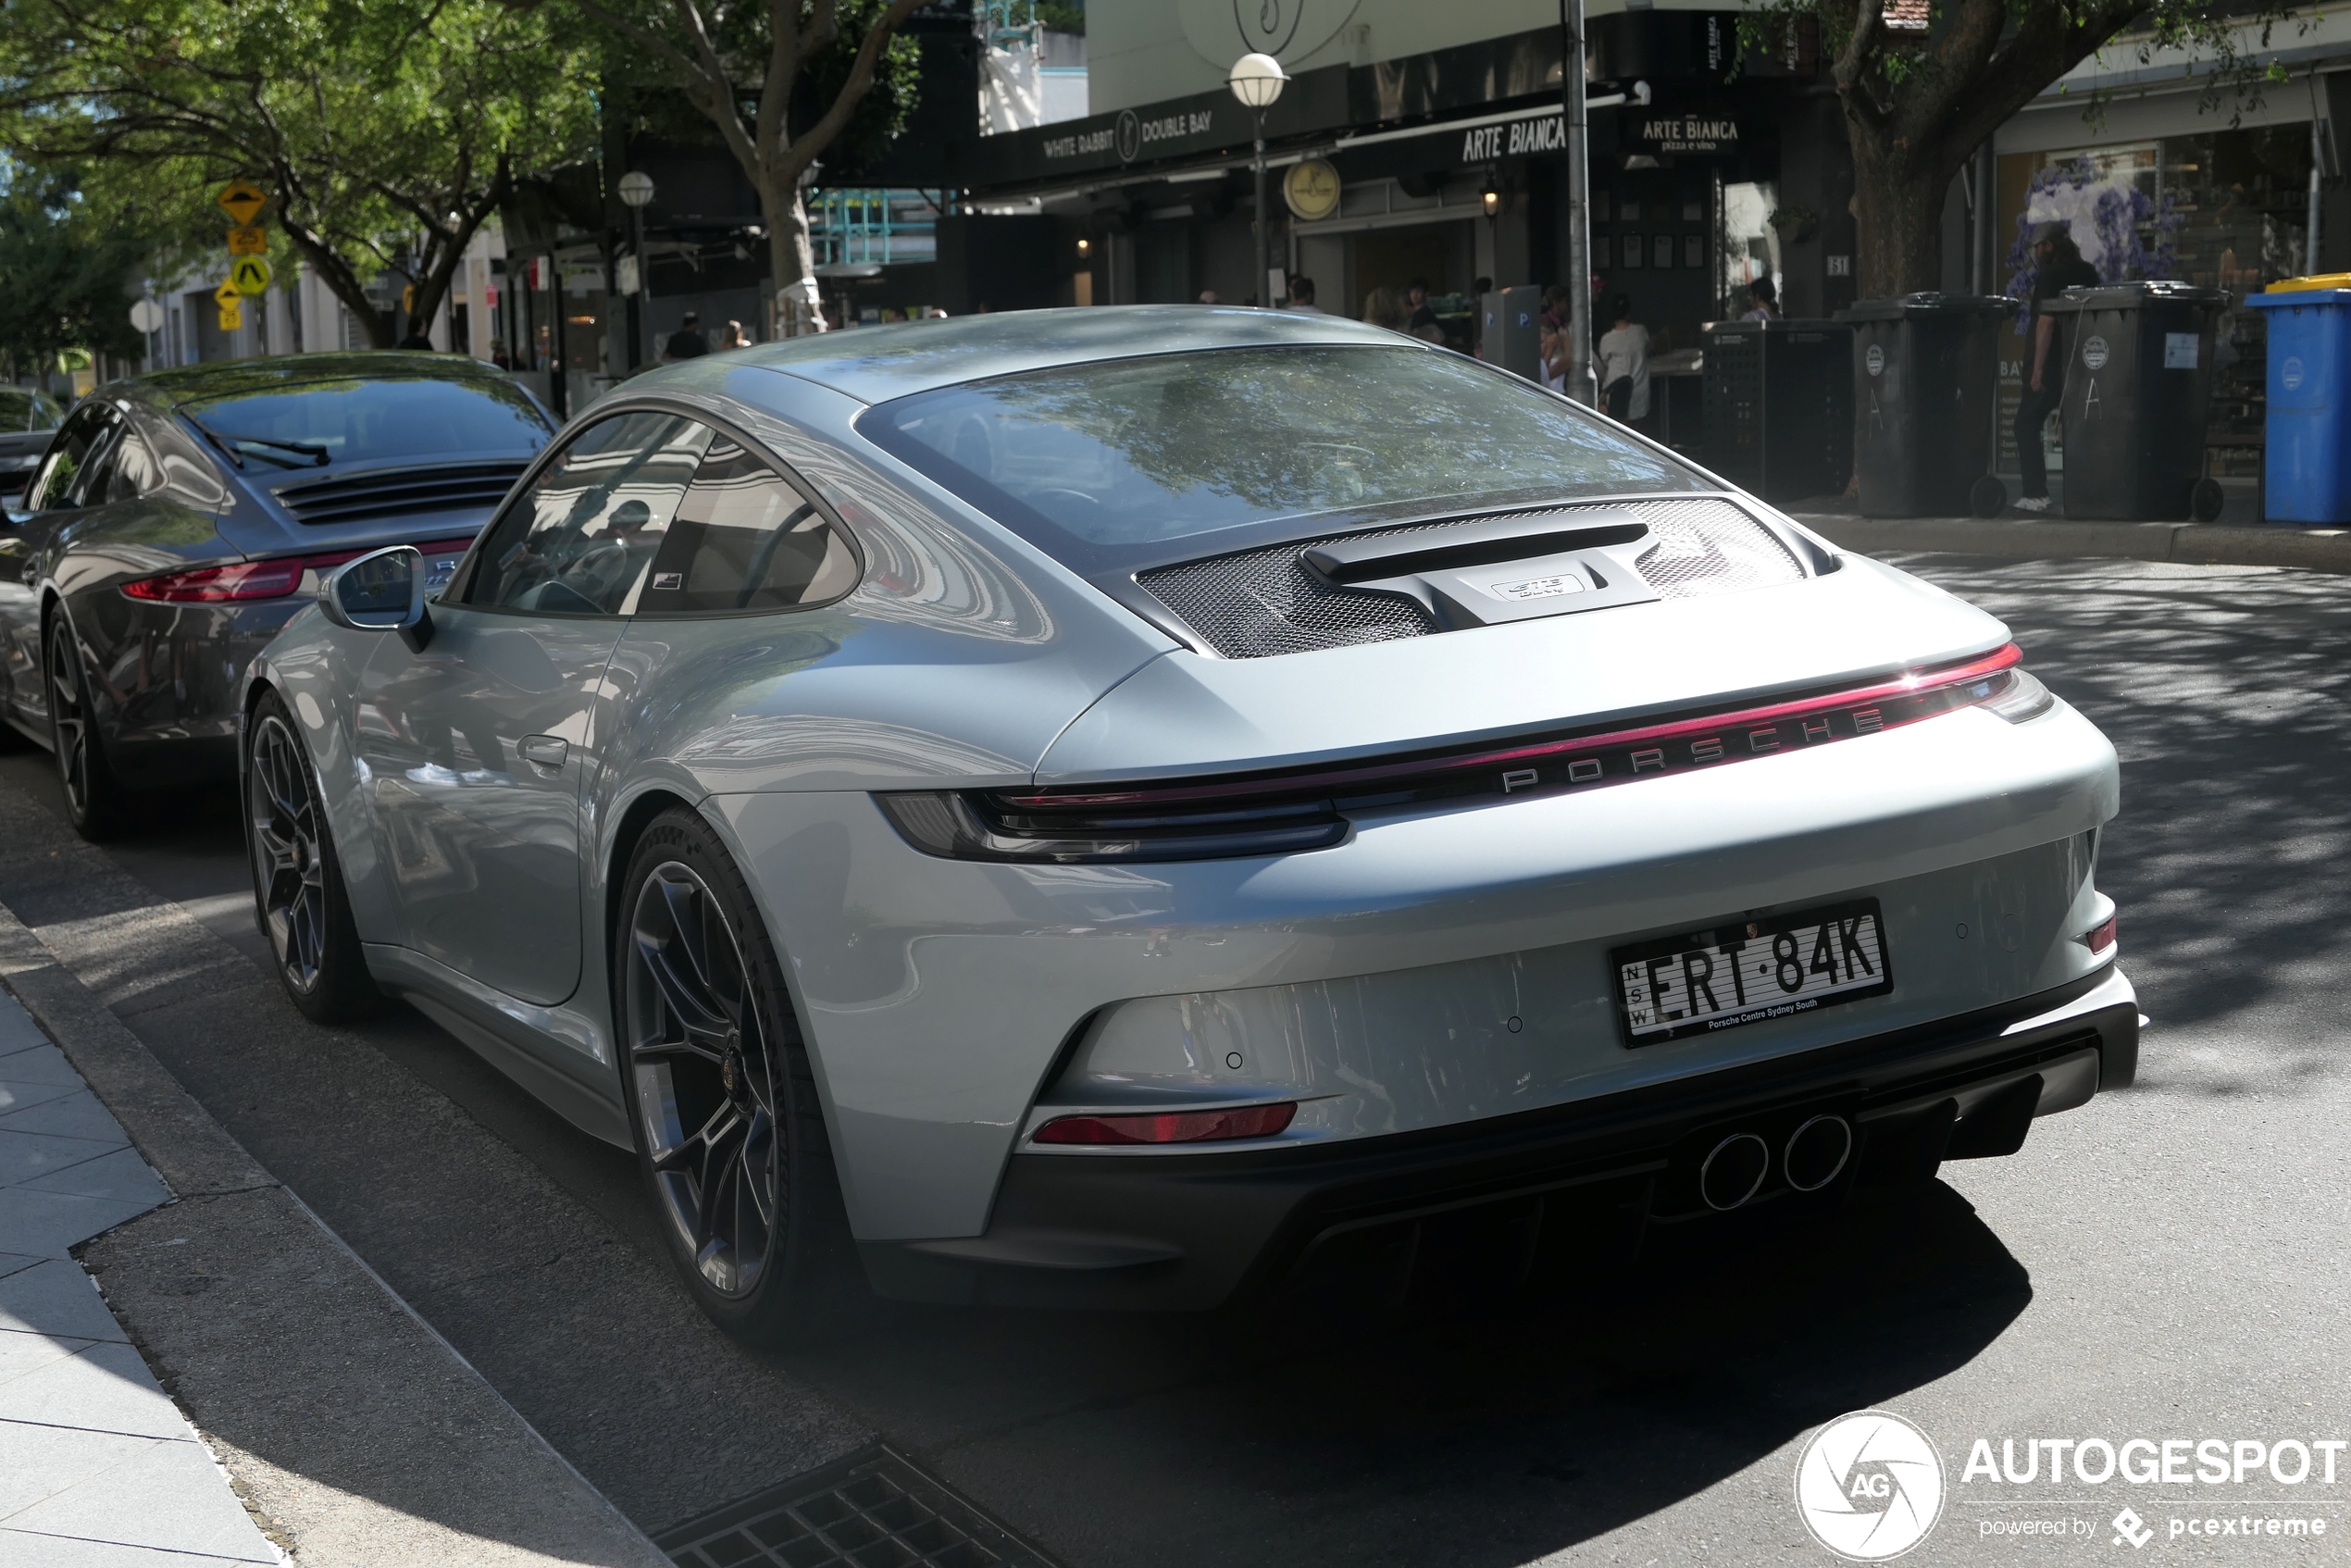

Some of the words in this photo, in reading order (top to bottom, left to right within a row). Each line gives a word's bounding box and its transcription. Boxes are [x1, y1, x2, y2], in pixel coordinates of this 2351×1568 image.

[1042, 136, 1076, 159] WHITE
[1077, 129, 1115, 156] RABBIT
[1141, 115, 1187, 143] DOUBLE
[1188, 110, 1213, 133] BAY
[1462, 125, 1504, 162] ARTE
[1508, 116, 1566, 156] BIANCA
[1643, 120, 1681, 139] ARTE
[1686, 120, 1738, 140] BIANCA
[1661, 140, 1686, 153] pizza
[1687, 142, 1695, 150] e
[1696, 140, 1717, 151] vino
[1832, 258, 1846, 275] 51
[2084, 377, 2102, 420] A
[1502, 708, 1885, 793] PORSCHE
[298, 746, 323, 831] MICHELIN
[1708, 1016, 1740, 1030] Porsche
[1741, 1011, 1766, 1022] Centre
[1767, 1004, 1795, 1017] Sydney
[1796, 998, 1818, 1010] South
